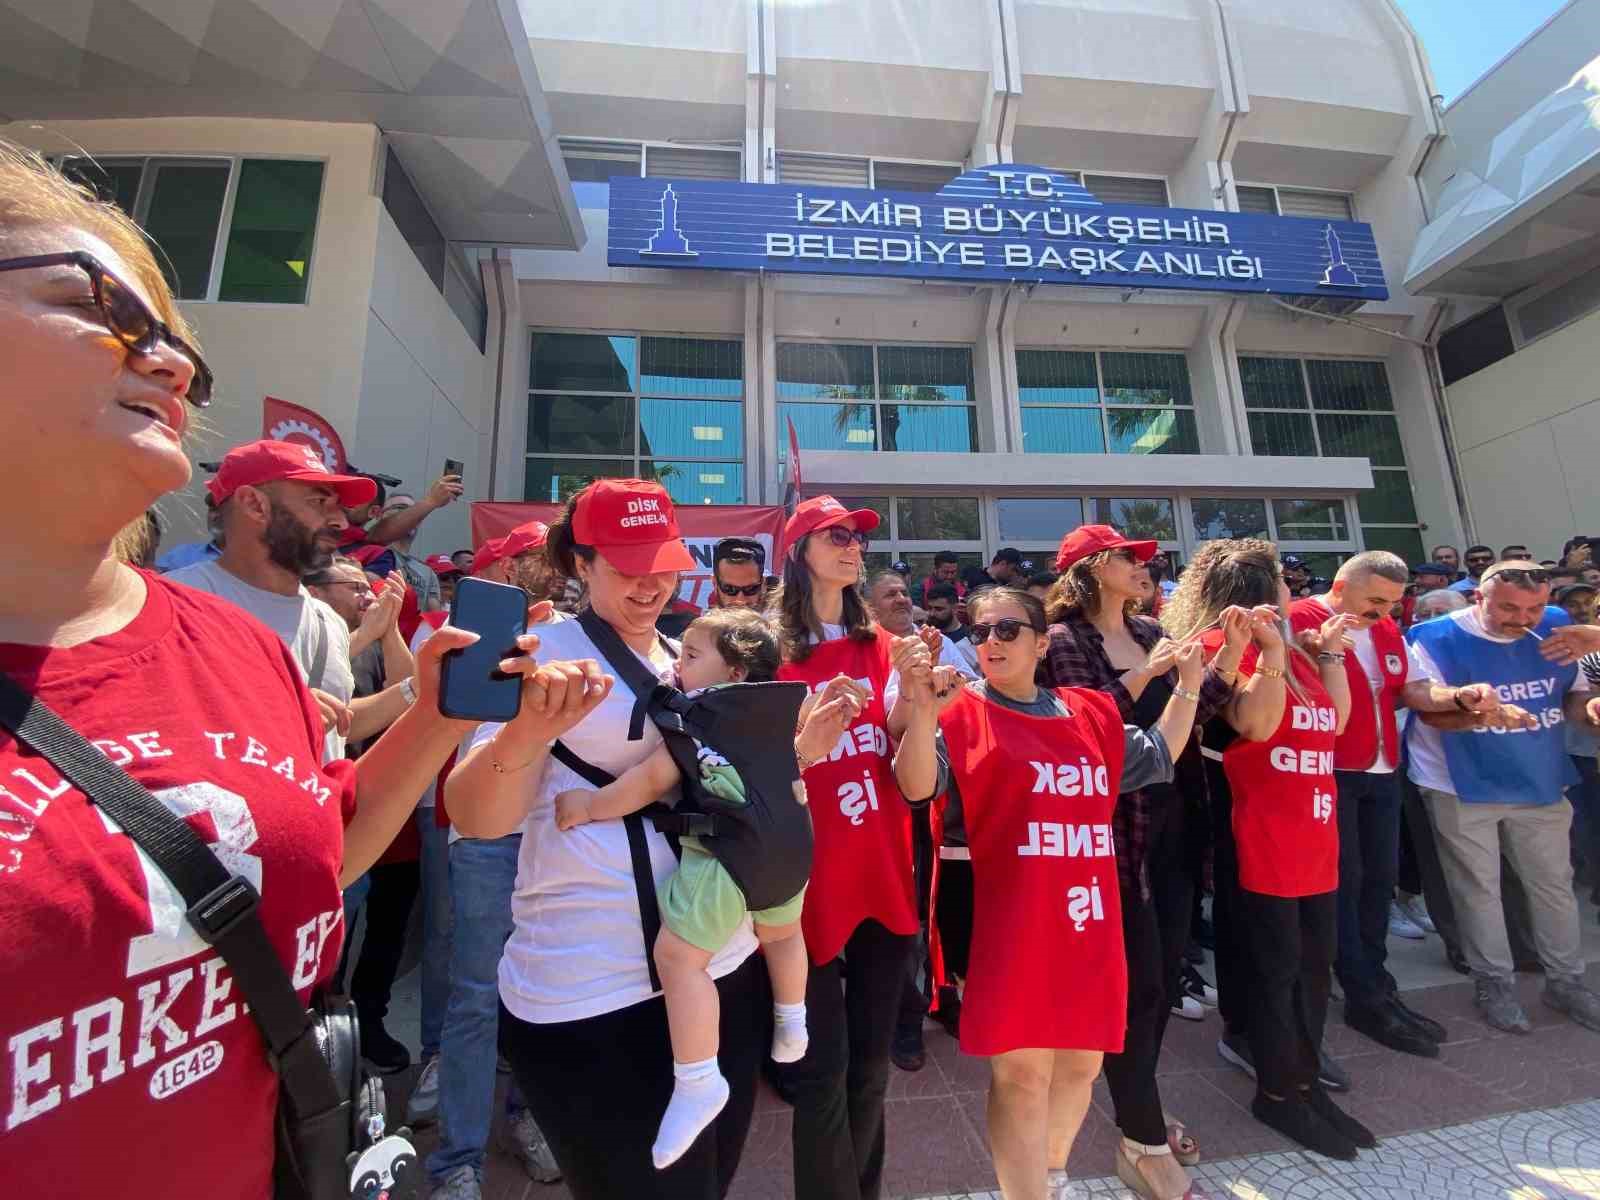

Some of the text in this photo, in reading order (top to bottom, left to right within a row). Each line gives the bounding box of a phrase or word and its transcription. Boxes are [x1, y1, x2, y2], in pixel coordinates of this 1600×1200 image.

[989, 170, 1064, 198] T.C.
[796, 193, 1230, 244] İZMİR BÜYÜKŞEHİR
[765, 231, 1265, 281] BELEDİYE BAŞKANLIĞI
[204, 730, 332, 807] TEAM
[158, 1044, 216, 1095] 1642
